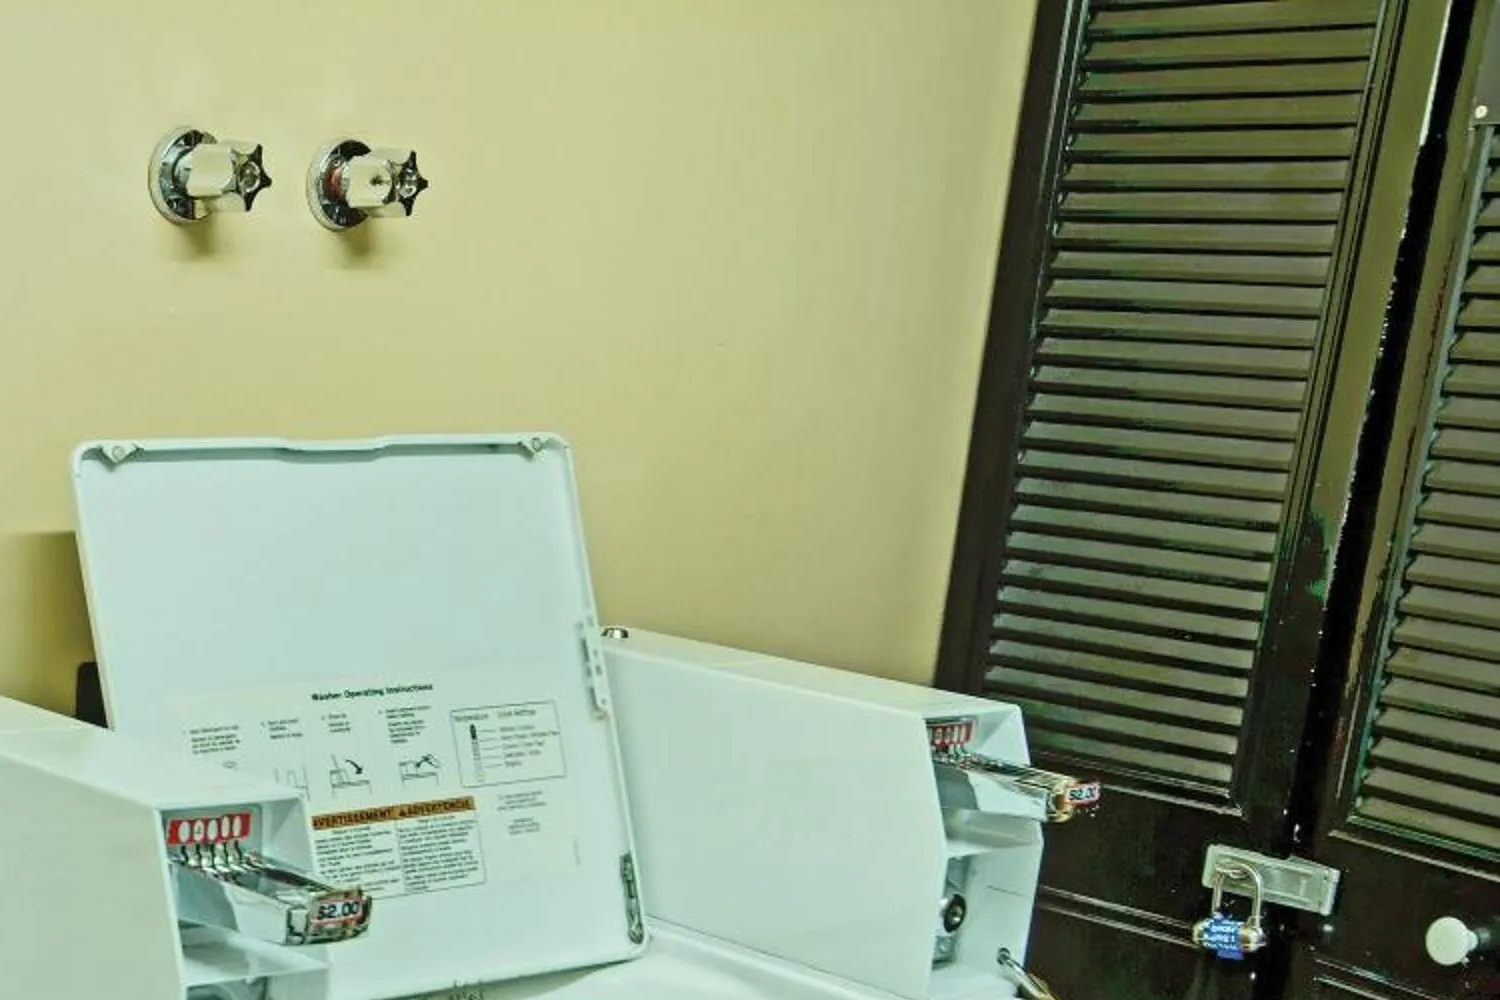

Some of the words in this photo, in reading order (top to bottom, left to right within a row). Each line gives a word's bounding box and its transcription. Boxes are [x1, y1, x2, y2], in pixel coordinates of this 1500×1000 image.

[311, 692, 342, 701] Washer
[343, 688, 384, 700] Operating
[385, 683, 433, 695] Instructions
[317, 901, 360, 920] $2.00
